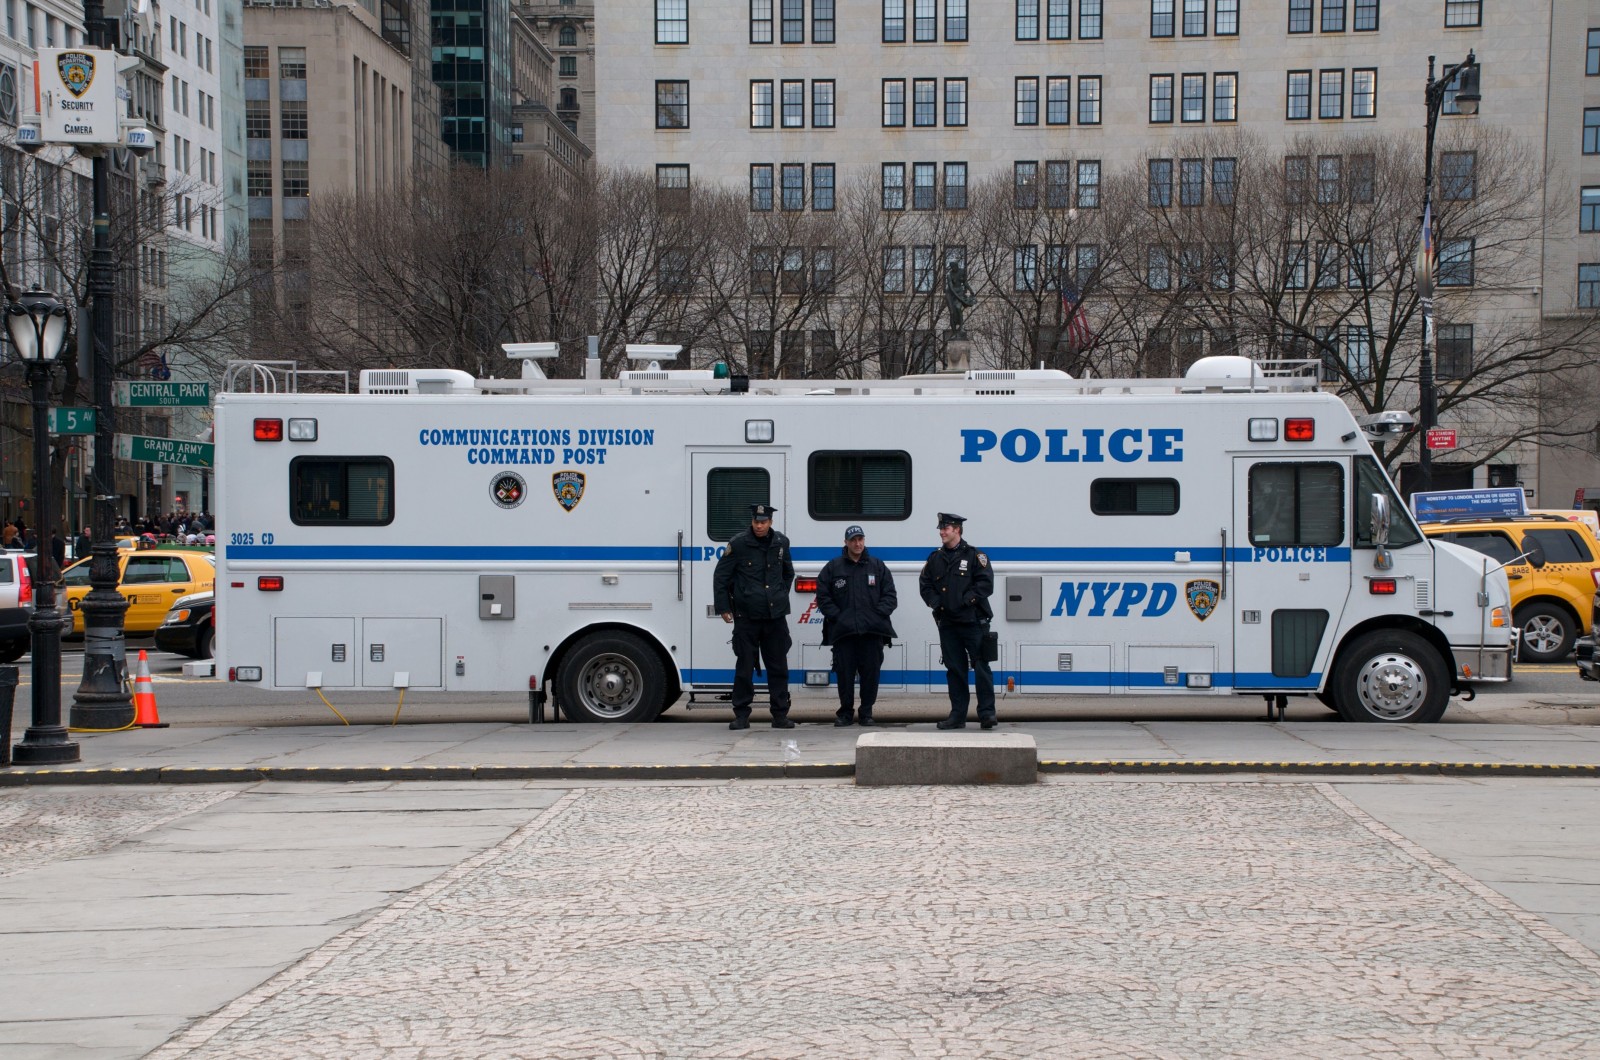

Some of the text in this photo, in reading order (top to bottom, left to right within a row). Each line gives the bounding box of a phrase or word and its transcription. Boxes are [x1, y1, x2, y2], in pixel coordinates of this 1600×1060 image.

[59, 58, 93, 67] DEPARTMENT
[18, 129, 36, 140] NYPD
[128, 132, 146, 143] NYPD
[130, 384, 206, 397] CENTRAL PARK
[159, 397, 180, 405] SOUTH
[67, 411, 93, 430] 5 AV
[419, 429, 654, 445] COMMUNICATIONS DIVISION
[144, 439, 204, 455] GRAND ARMY
[960, 428, 1183, 463] POLICE
[158, 452, 188, 464] PLAZA
[467, 448, 607, 464] COMMAND POST
[231, 532, 274, 545] 3025 CD
[1253, 546, 1325, 562] POLICE
[1050, 582, 1177, 617] NYPD
